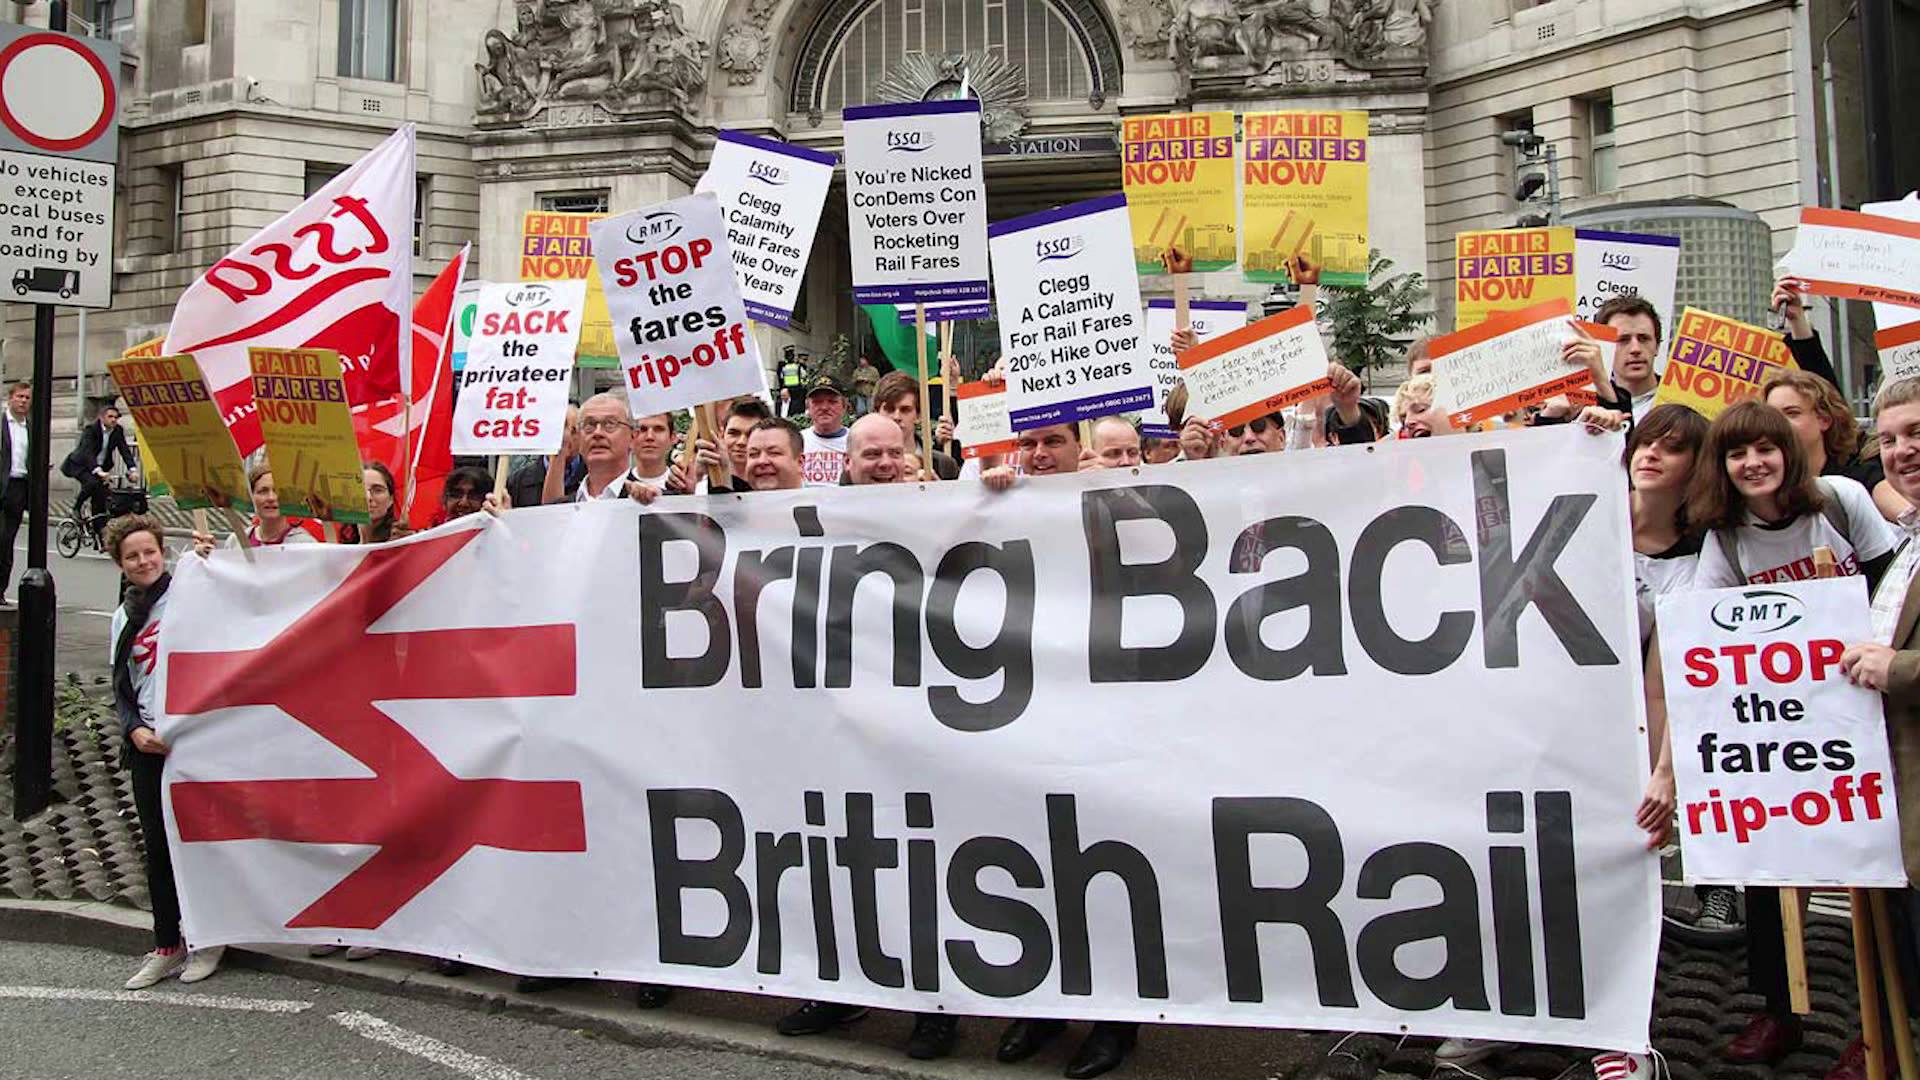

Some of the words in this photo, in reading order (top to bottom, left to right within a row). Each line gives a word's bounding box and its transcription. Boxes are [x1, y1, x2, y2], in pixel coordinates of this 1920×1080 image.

[1126, 116, 1208, 140] FAIR
[1248, 115, 1341, 137] FAIR
[887, 130, 921, 147] tssa
[1009, 138, 1081, 155] STATION
[1126, 138, 1229, 162] FARES
[1248, 139, 1363, 161] FARES
[27, 166, 108, 187] vehicles
[748, 159, 781, 179] tssa
[854, 169, 907, 186] You're
[911, 164, 973, 183] Nicked
[1125, 161, 1197, 186] NOW
[1244, 162, 1327, 186] NOW
[15, 184, 84, 204] except
[738, 191, 782, 216] Clegg
[853, 190, 936, 208] ConDems
[940, 187, 977, 203] Con
[0, 203, 40, 218] ocal
[48, 205, 105, 225] buses
[729, 209, 796, 240] Calamity
[865, 212, 918, 229] Voters
[922, 209, 966, 226] Over
[11, 224, 48, 239] and
[56, 226, 85, 242] for
[529, 216, 583, 236] FAI
[638, 218, 675, 239] RMT
[528, 237, 584, 256] FAR
[727, 227, 756, 247] Rail
[758, 237, 801, 259] Fares
[873, 232, 960, 251] Rocketing
[1035, 236, 1071, 258] tssa
[1461, 233, 1548, 256] FAIR
[0, 243, 68, 264] oading
[76, 249, 99, 267] by
[613, 237, 714, 288] STOP
[875, 255, 906, 272] Rail
[911, 254, 961, 271] Fares
[1461, 253, 1570, 278] FARES
[1602, 251, 1631, 265] tssa
[521, 257, 591, 280] NOW
[761, 257, 799, 279] Over
[648, 282, 693, 307] the
[743, 273, 785, 296] Years
[1038, 274, 1090, 296] Clegg
[1459, 277, 1535, 303] NOW
[1597, 280, 1638, 297] Clegg
[1858, 286, 1878, 297] Fair
[1880, 290, 1907, 302] Fares
[515, 291, 547, 302] RMT
[1020, 306, 1034, 324] A
[1037, 292, 1115, 321] Calamity
[1578, 295, 1588, 308] A
[482, 309, 571, 337] SACK
[629, 305, 727, 346] fares
[1010, 331, 1039, 349] For
[1044, 321, 1077, 343] Rail
[1082, 313, 1133, 335] Fares
[502, 340, 539, 357] the
[1685, 314, 1788, 363] FAIR
[251, 352, 320, 376] FAIR
[627, 323, 746, 390] rip-off
[1010, 351, 1047, 373] 20%
[1051, 344, 1090, 365] Hike
[1095, 335, 1139, 355] Over
[1677, 340, 1754, 381] FAR
[115, 360, 180, 386] FAIR
[464, 366, 569, 388] privateer
[1022, 371, 1062, 394] Next
[1066, 368, 1077, 386] 3
[1080, 361, 1132, 382] Years
[1262, 363, 1288, 382] 2015
[1663, 362, 1759, 405] NOW
[124, 381, 206, 406] FARES
[255, 378, 343, 401] FARES
[1285, 387, 1311, 402] Fares
[1538, 382, 1565, 396] Fares
[1566, 374, 1589, 387] Now
[485, 386, 537, 410] fat-
[132, 404, 190, 428] NOW
[254, 402, 318, 426] NOW
[472, 415, 540, 438] cats
[638, 505, 1036, 732] Bring
[1082, 448, 1620, 684] Back
[1730, 602, 1788, 623] RMT
[1684, 639, 1846, 688] STOP
[1732, 693, 1805, 724] the
[1697, 732, 1856, 773] fares
[1685, 772, 1884, 844] rip-off
[646, 787, 1170, 1000] British
[1212, 790, 1586, 1020] Rail
